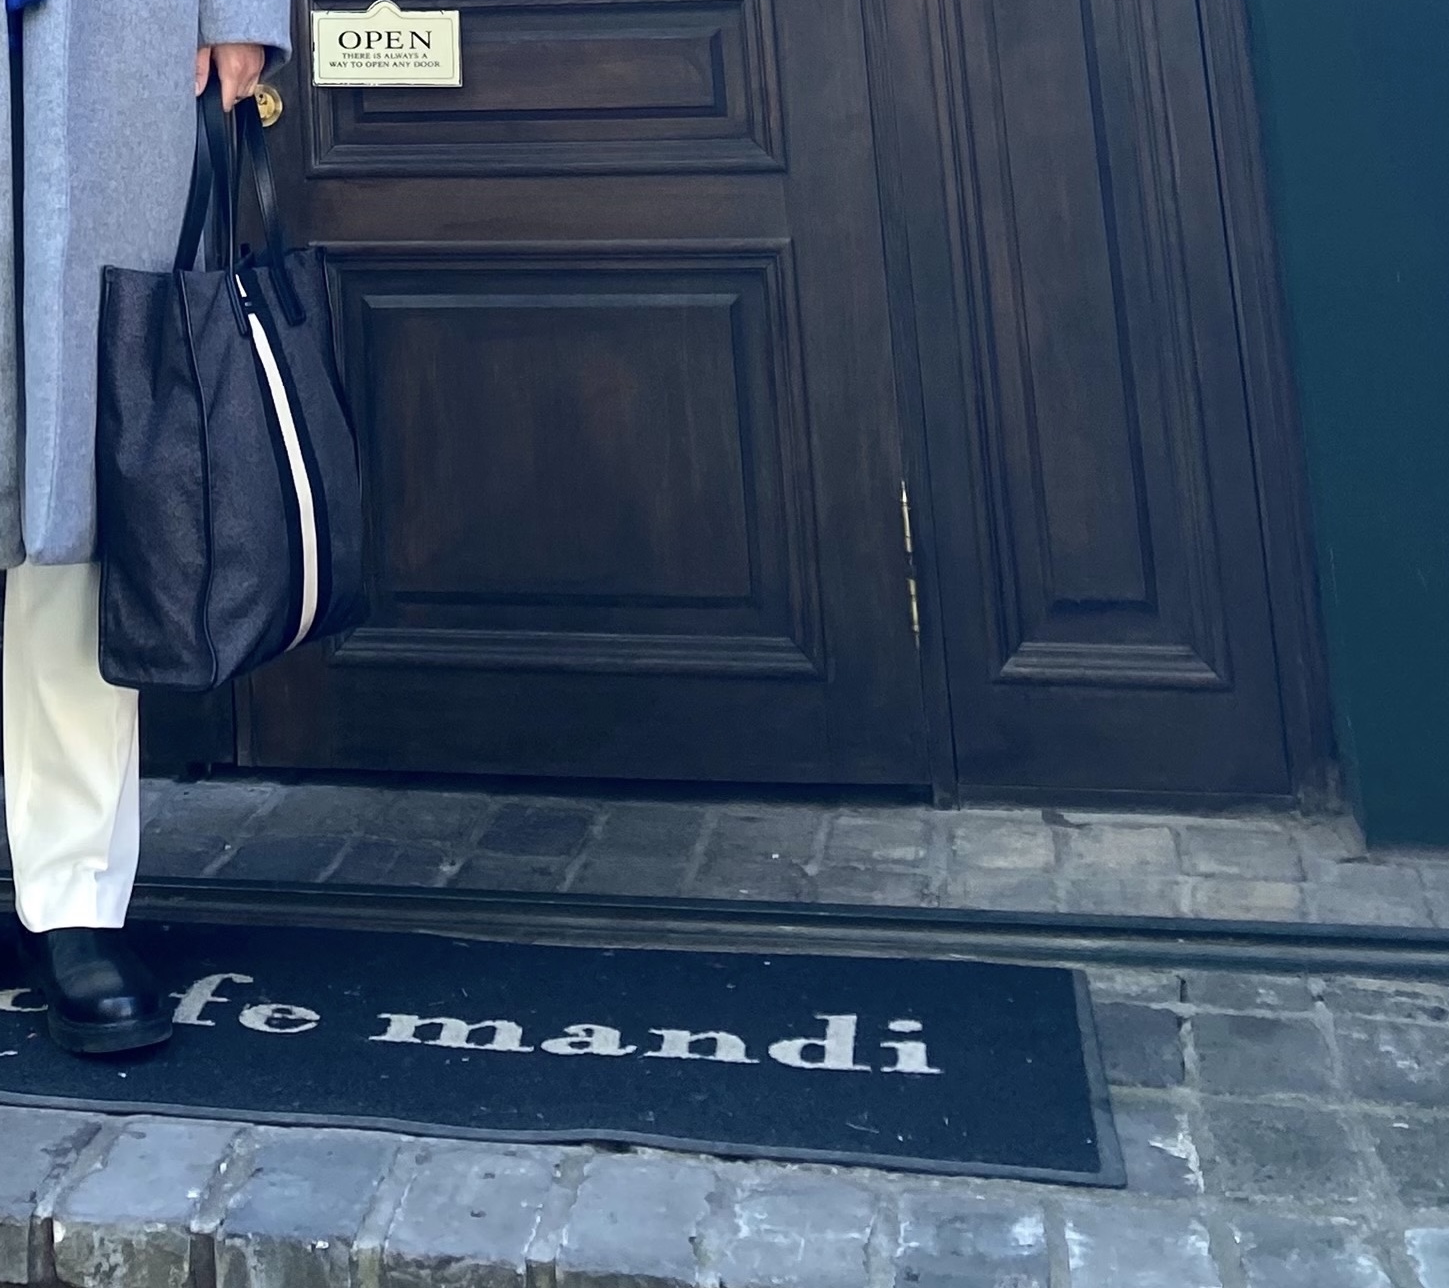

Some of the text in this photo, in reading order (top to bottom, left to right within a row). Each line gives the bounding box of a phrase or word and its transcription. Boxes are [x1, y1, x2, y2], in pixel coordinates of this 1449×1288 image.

[338, 30, 432, 50] OPEN
[342, 52, 428, 60] THERE IS ALWAYS A
[369, 1013, 943, 1073] mandi
